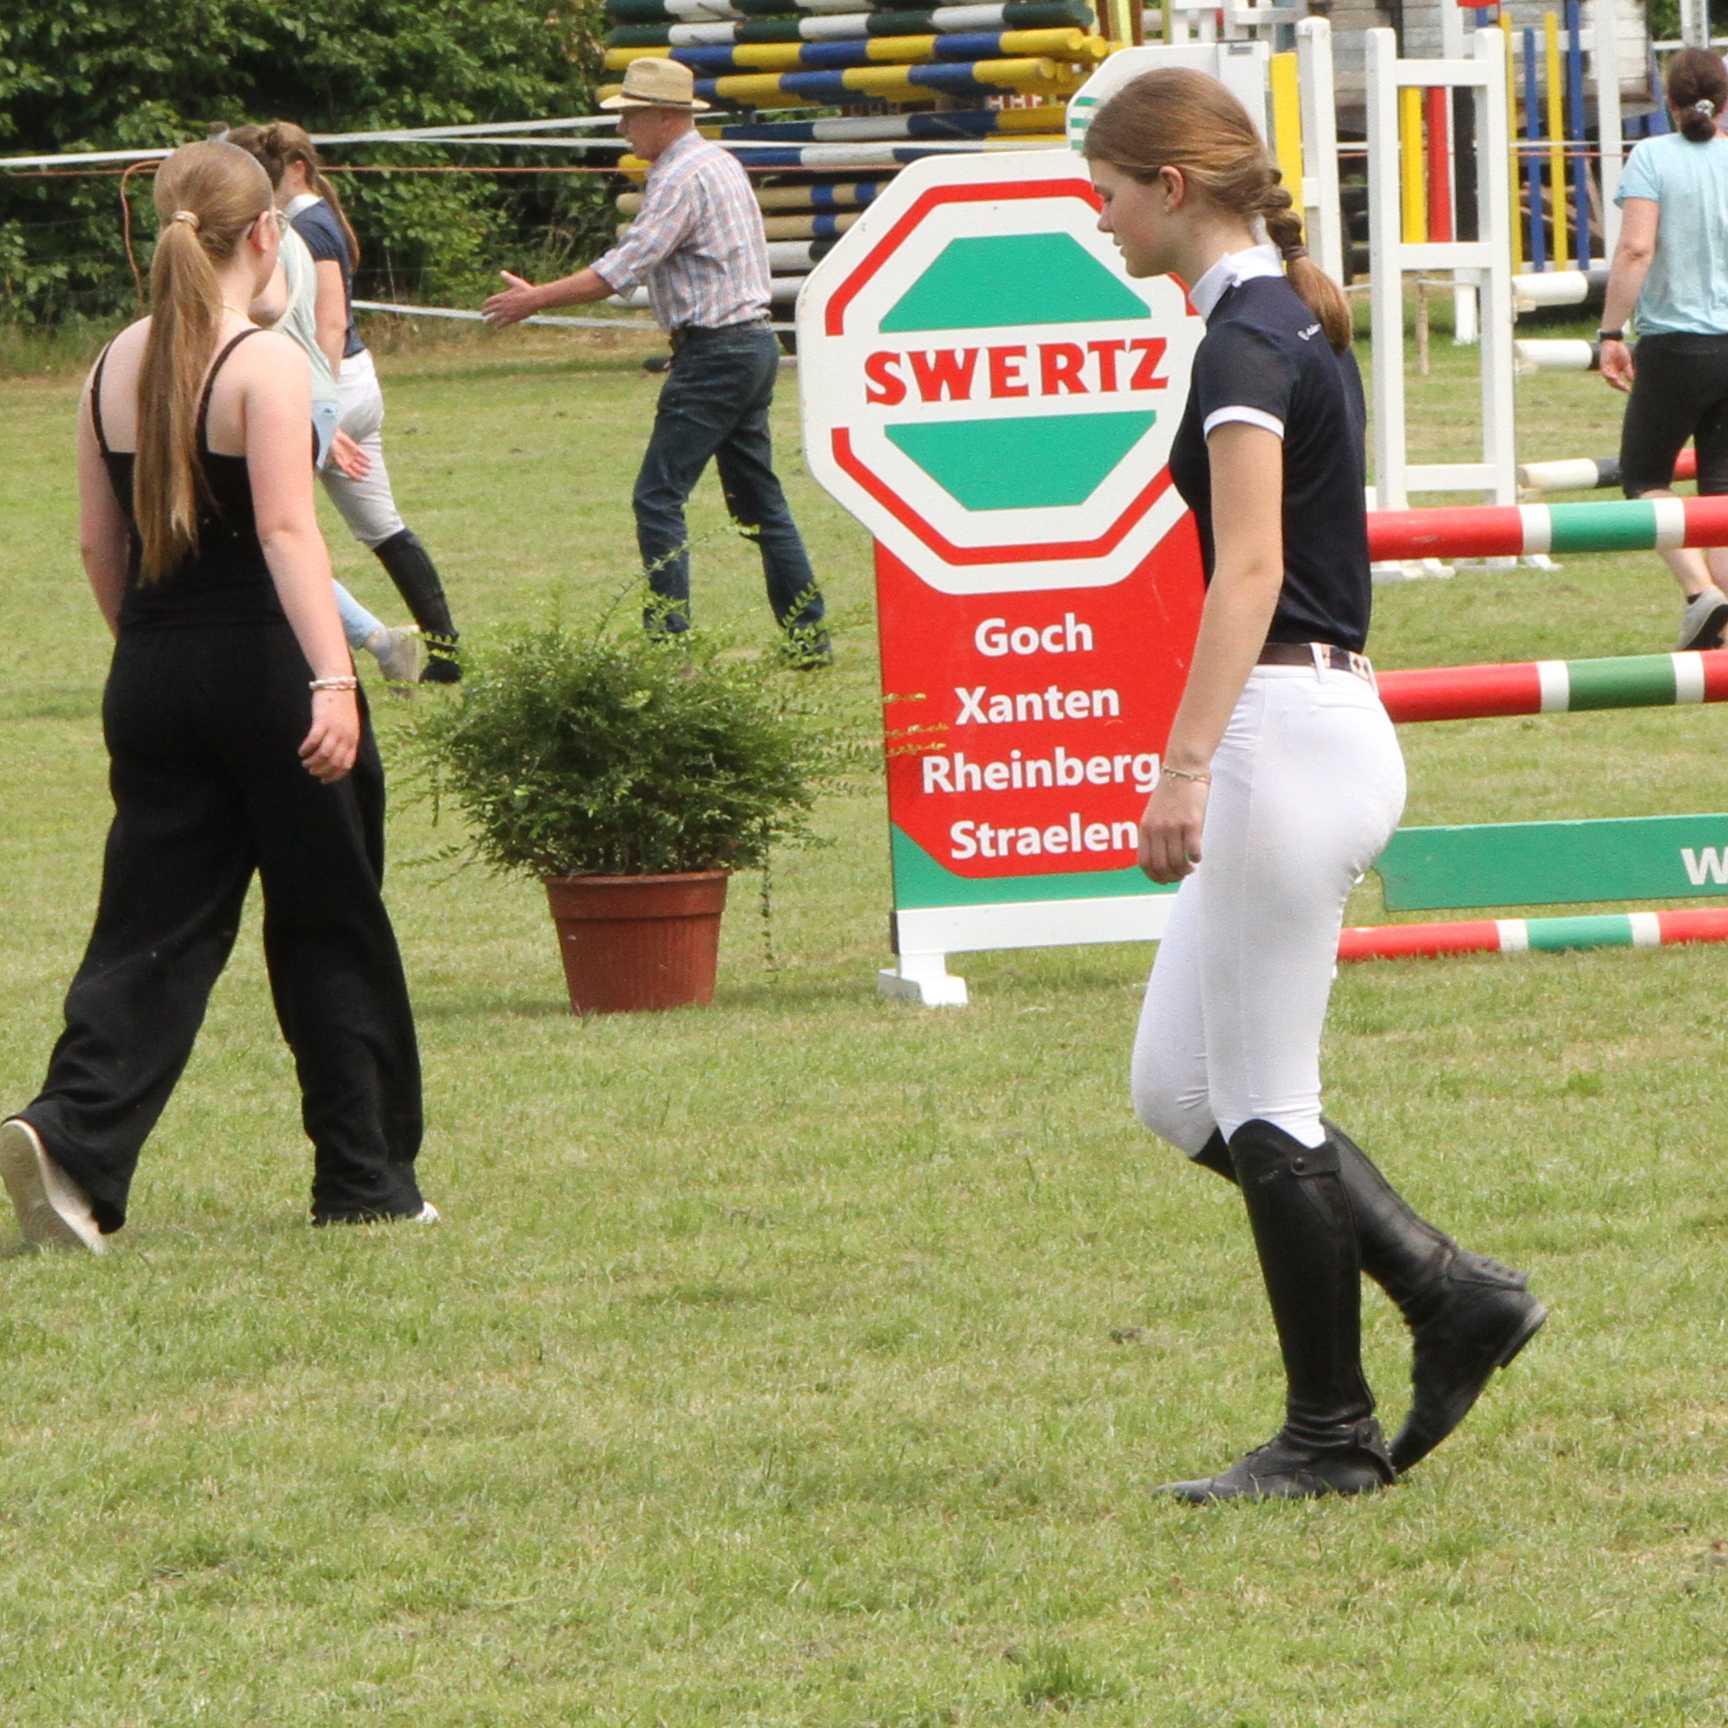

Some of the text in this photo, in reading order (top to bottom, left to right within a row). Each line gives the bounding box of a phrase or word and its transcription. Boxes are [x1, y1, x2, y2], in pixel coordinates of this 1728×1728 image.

[864, 336, 1169, 407] SWERTZ
[974, 611, 1094, 658] Goch
[954, 684, 1121, 726] Xanten
[922, 746, 1160, 794] Rheinberg
[949, 812, 1139, 860] Straelen
